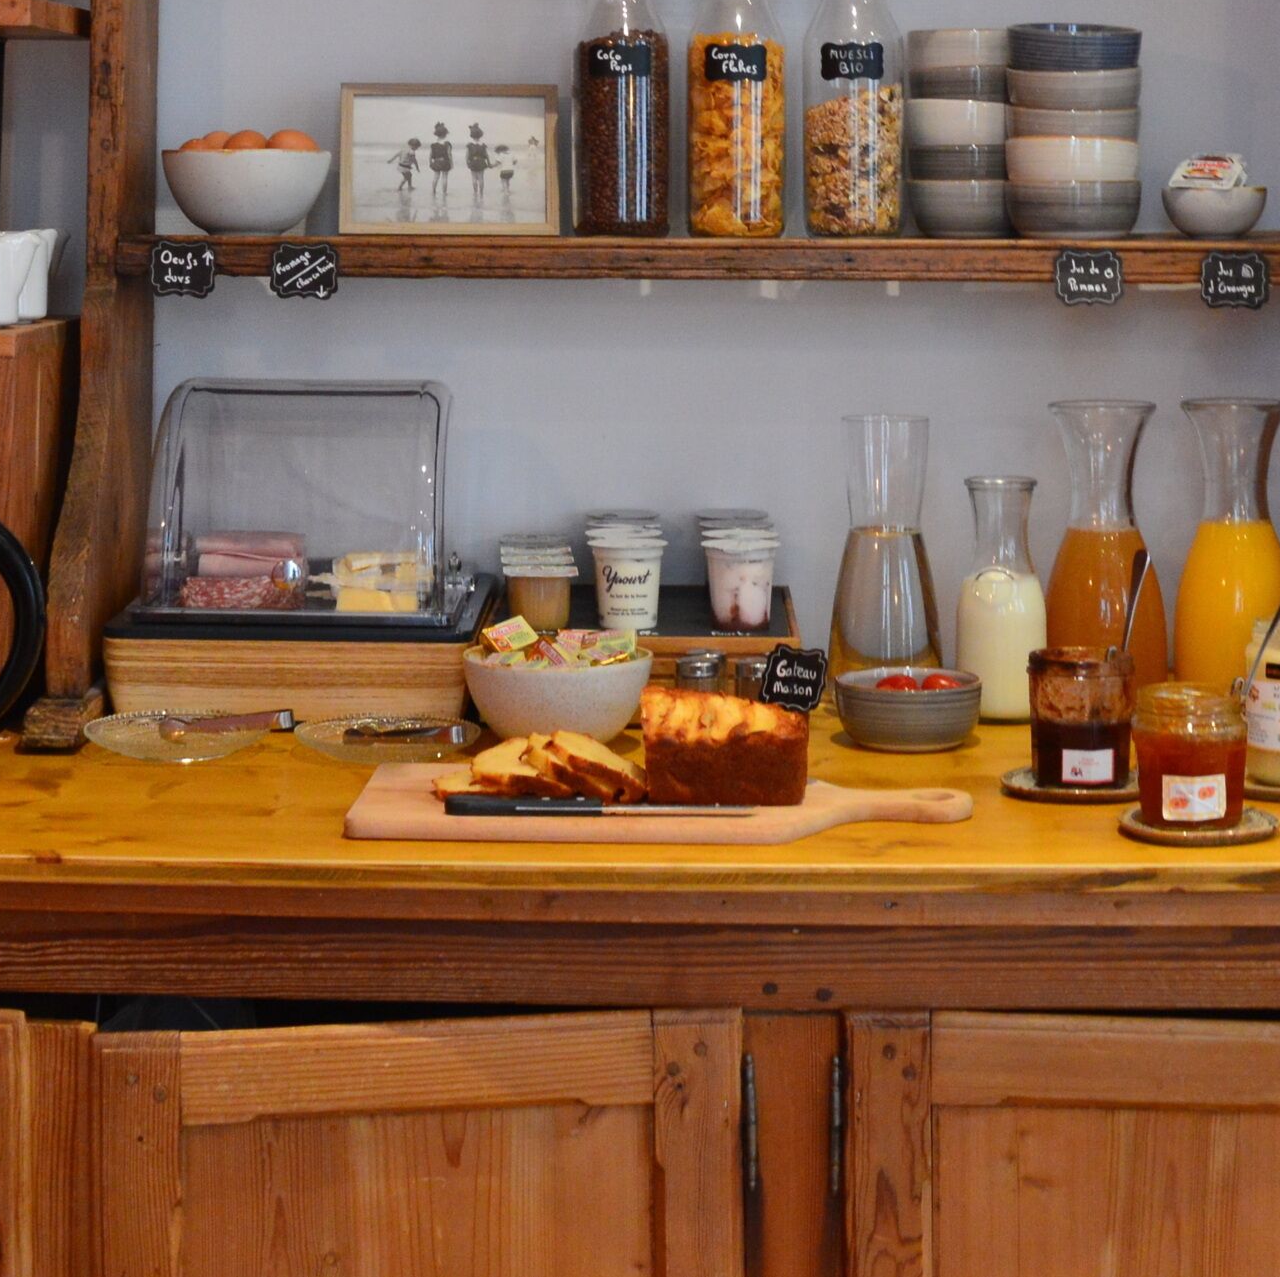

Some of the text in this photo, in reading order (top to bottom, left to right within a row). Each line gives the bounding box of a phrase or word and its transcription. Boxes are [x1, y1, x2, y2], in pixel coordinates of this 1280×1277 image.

[711, 47, 737, 60] Corn
[610, 60, 632, 73] Pops
[839, 62, 864, 74] BIO
[164, 268, 191, 284] durs
[602, 565, 651, 593] Yaourt
